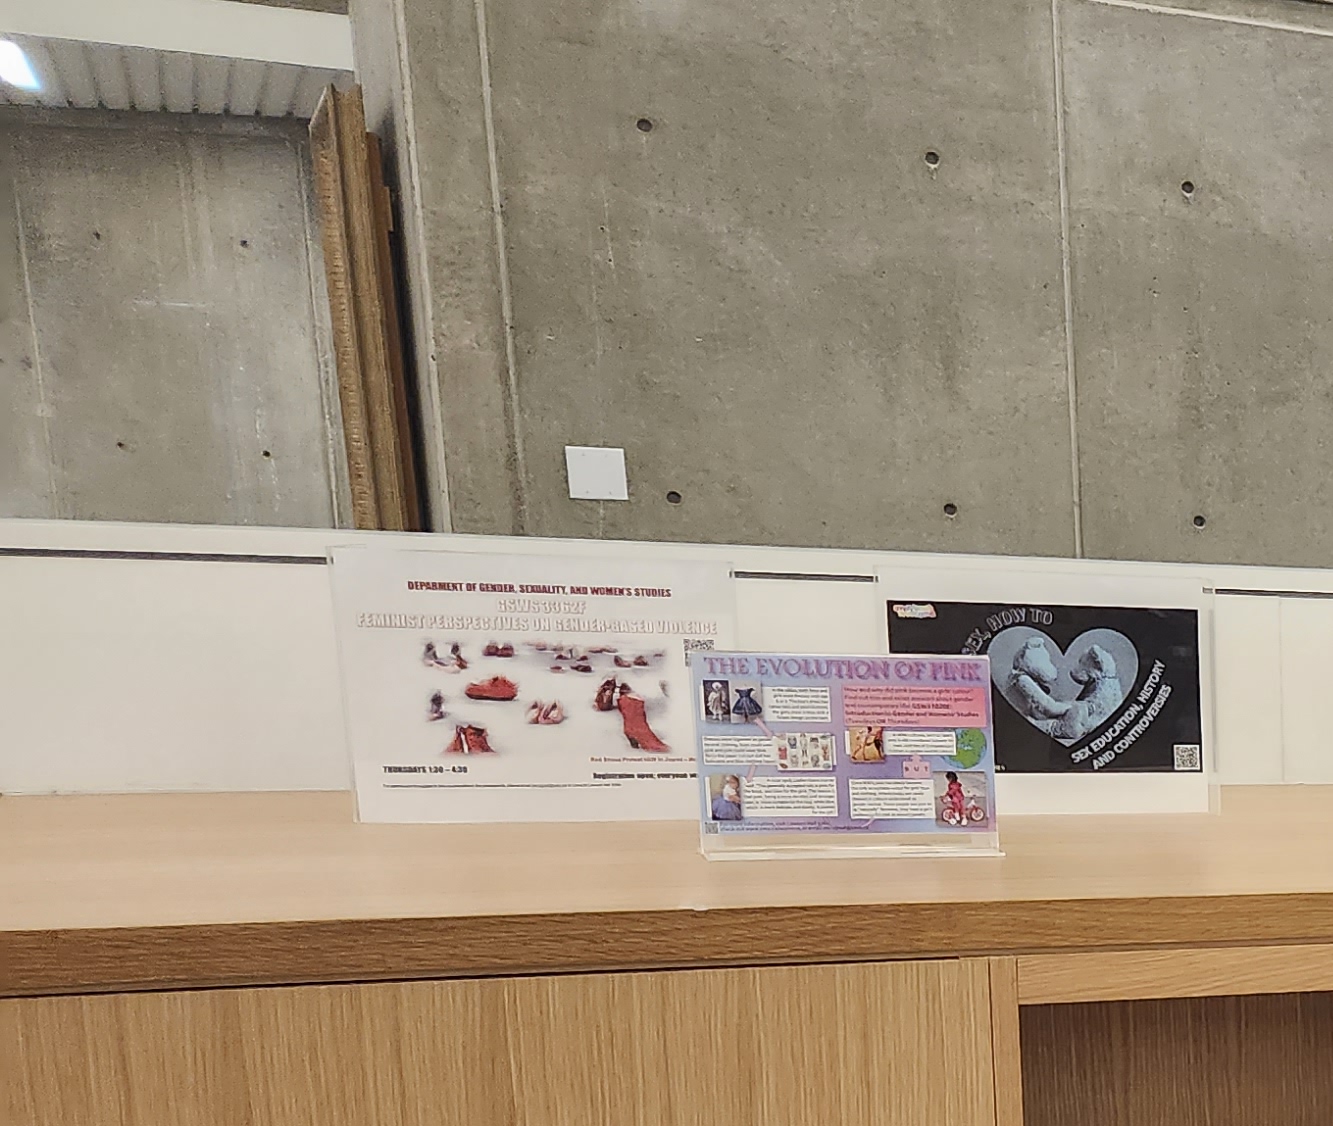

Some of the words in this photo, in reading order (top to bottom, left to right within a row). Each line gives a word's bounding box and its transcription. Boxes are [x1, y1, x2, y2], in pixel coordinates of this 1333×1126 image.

[466, 582, 477, 592] OF
[479, 583, 517, 594] GENDER,
[519, 583, 568, 596] SEXUALITY,
[570, 585, 588, 595] AND
[634, 587, 671, 598] STUDIES
[357, 612, 425, 629] FEMINIST
[428, 614, 530, 631] PERSPECTIVES
[531, 617, 551, 631] ON
[554, 618, 654, 633] GENDER-BASED
[656, 620, 718, 635] VIOLENCE
[985, 607, 1027, 632] HOW
[1029, 607, 1054, 625] TO
[703, 656, 749, 676] THE
[755, 658, 890, 680] EVOLUTION
[893, 661, 927, 680] OF
[931, 662, 982, 682] PINK
[1071, 746, 1091, 764] SEX
[1092, 701, 1145, 754] EDUCATION,
[1138, 659, 1166, 702] HISTORY
[1092, 751, 1116, 770] AND
[1113, 683, 1173, 754] CONTROVERSIES
